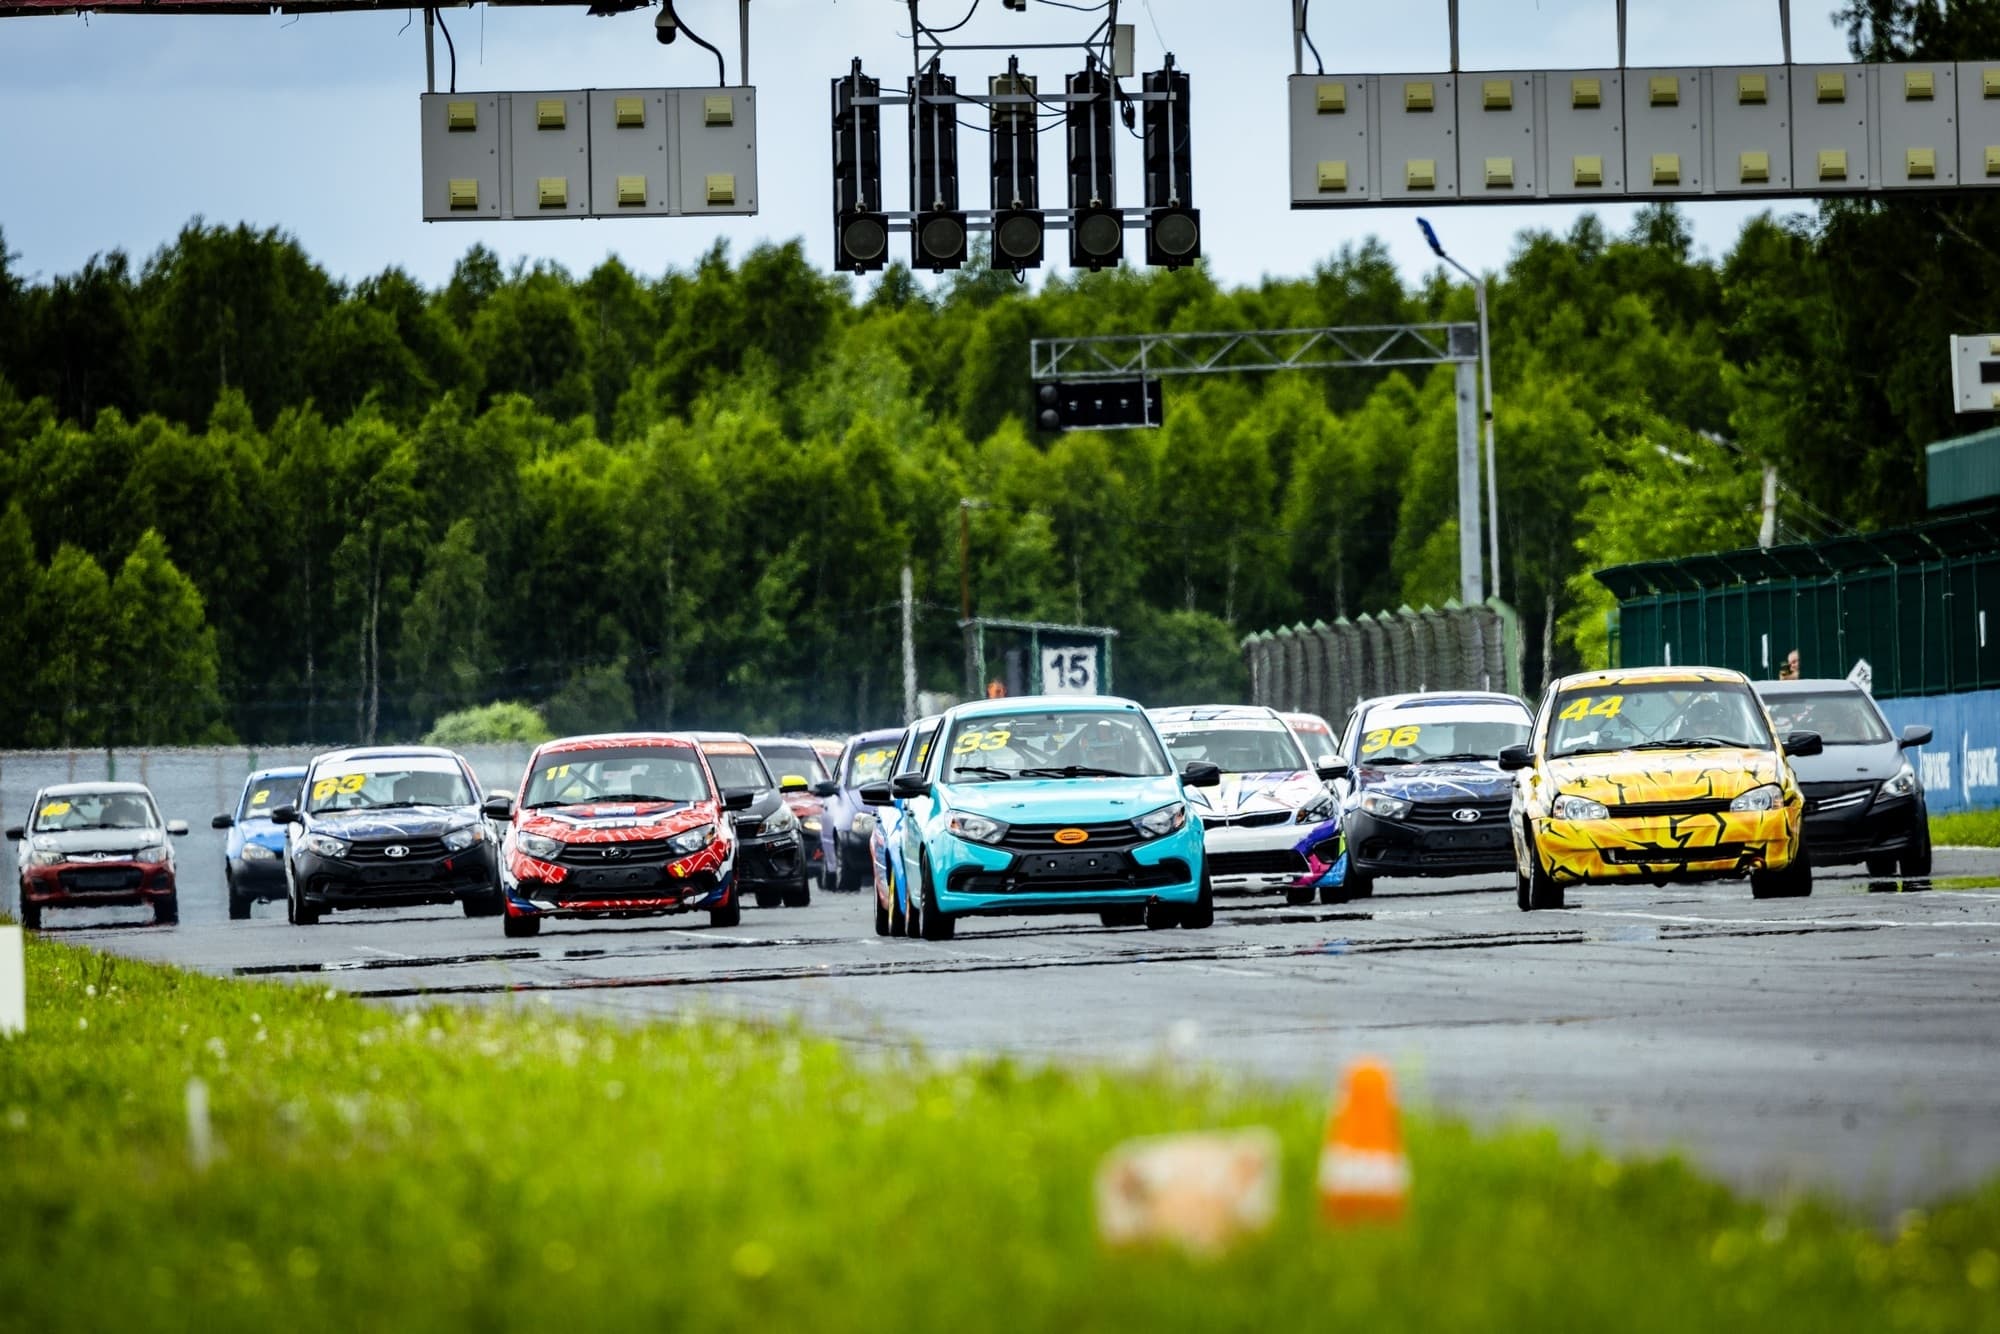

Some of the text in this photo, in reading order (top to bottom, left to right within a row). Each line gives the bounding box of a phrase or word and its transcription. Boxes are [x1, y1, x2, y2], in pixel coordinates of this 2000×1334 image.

[1050, 654, 1090, 688] 15
[1559, 695, 1624, 721] 44
[953, 730, 1011, 754] 33
[1361, 725, 1421, 753] 36
[546, 764, 571, 781] 11
